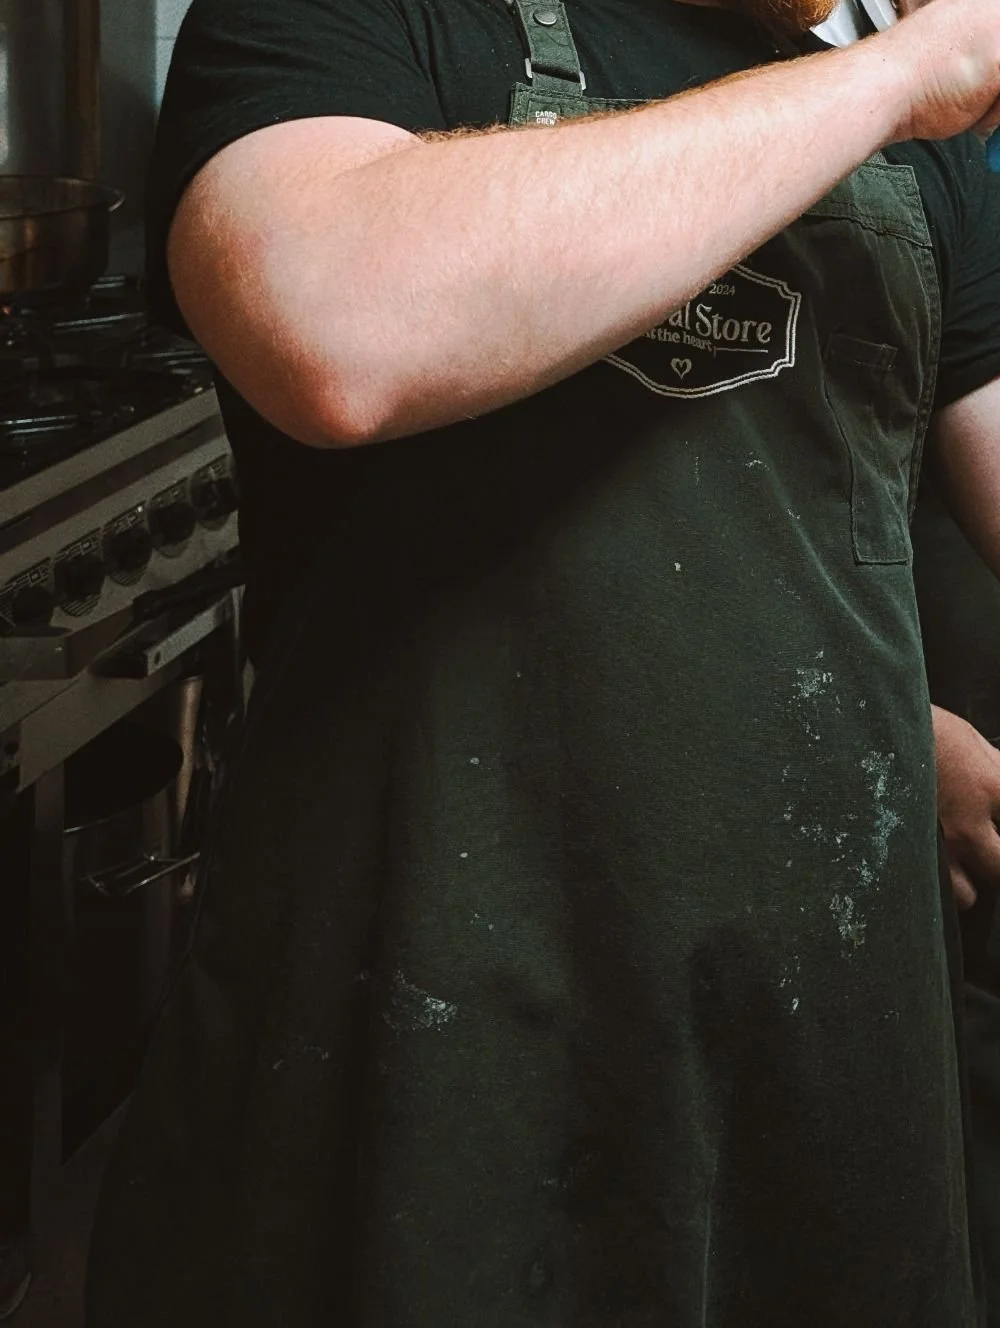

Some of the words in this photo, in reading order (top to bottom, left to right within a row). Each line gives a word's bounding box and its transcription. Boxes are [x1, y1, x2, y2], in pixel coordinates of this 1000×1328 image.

[535, 110, 557, 120] CARGO
[536, 117, 556, 127] CREW
[709, 282, 736, 296] 2024
[696, 303, 773, 344] Store
[657, 327, 681, 344] the
